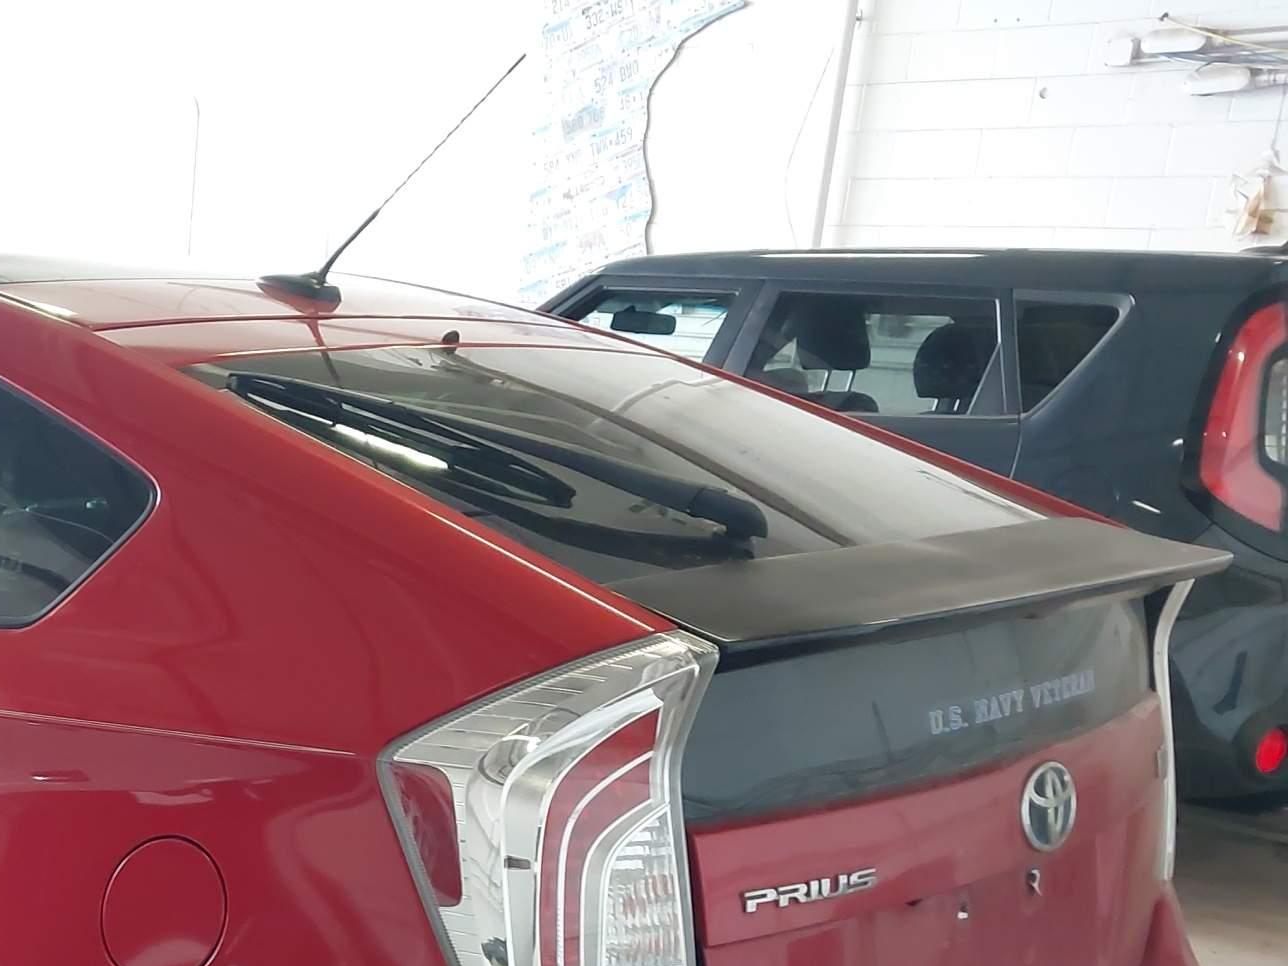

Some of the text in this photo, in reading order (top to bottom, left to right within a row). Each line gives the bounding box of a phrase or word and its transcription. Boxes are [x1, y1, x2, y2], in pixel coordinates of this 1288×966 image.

[929, 669, 1096, 735] U.S. NAVY VETERAN
[743, 868, 878, 913] PRIUS
